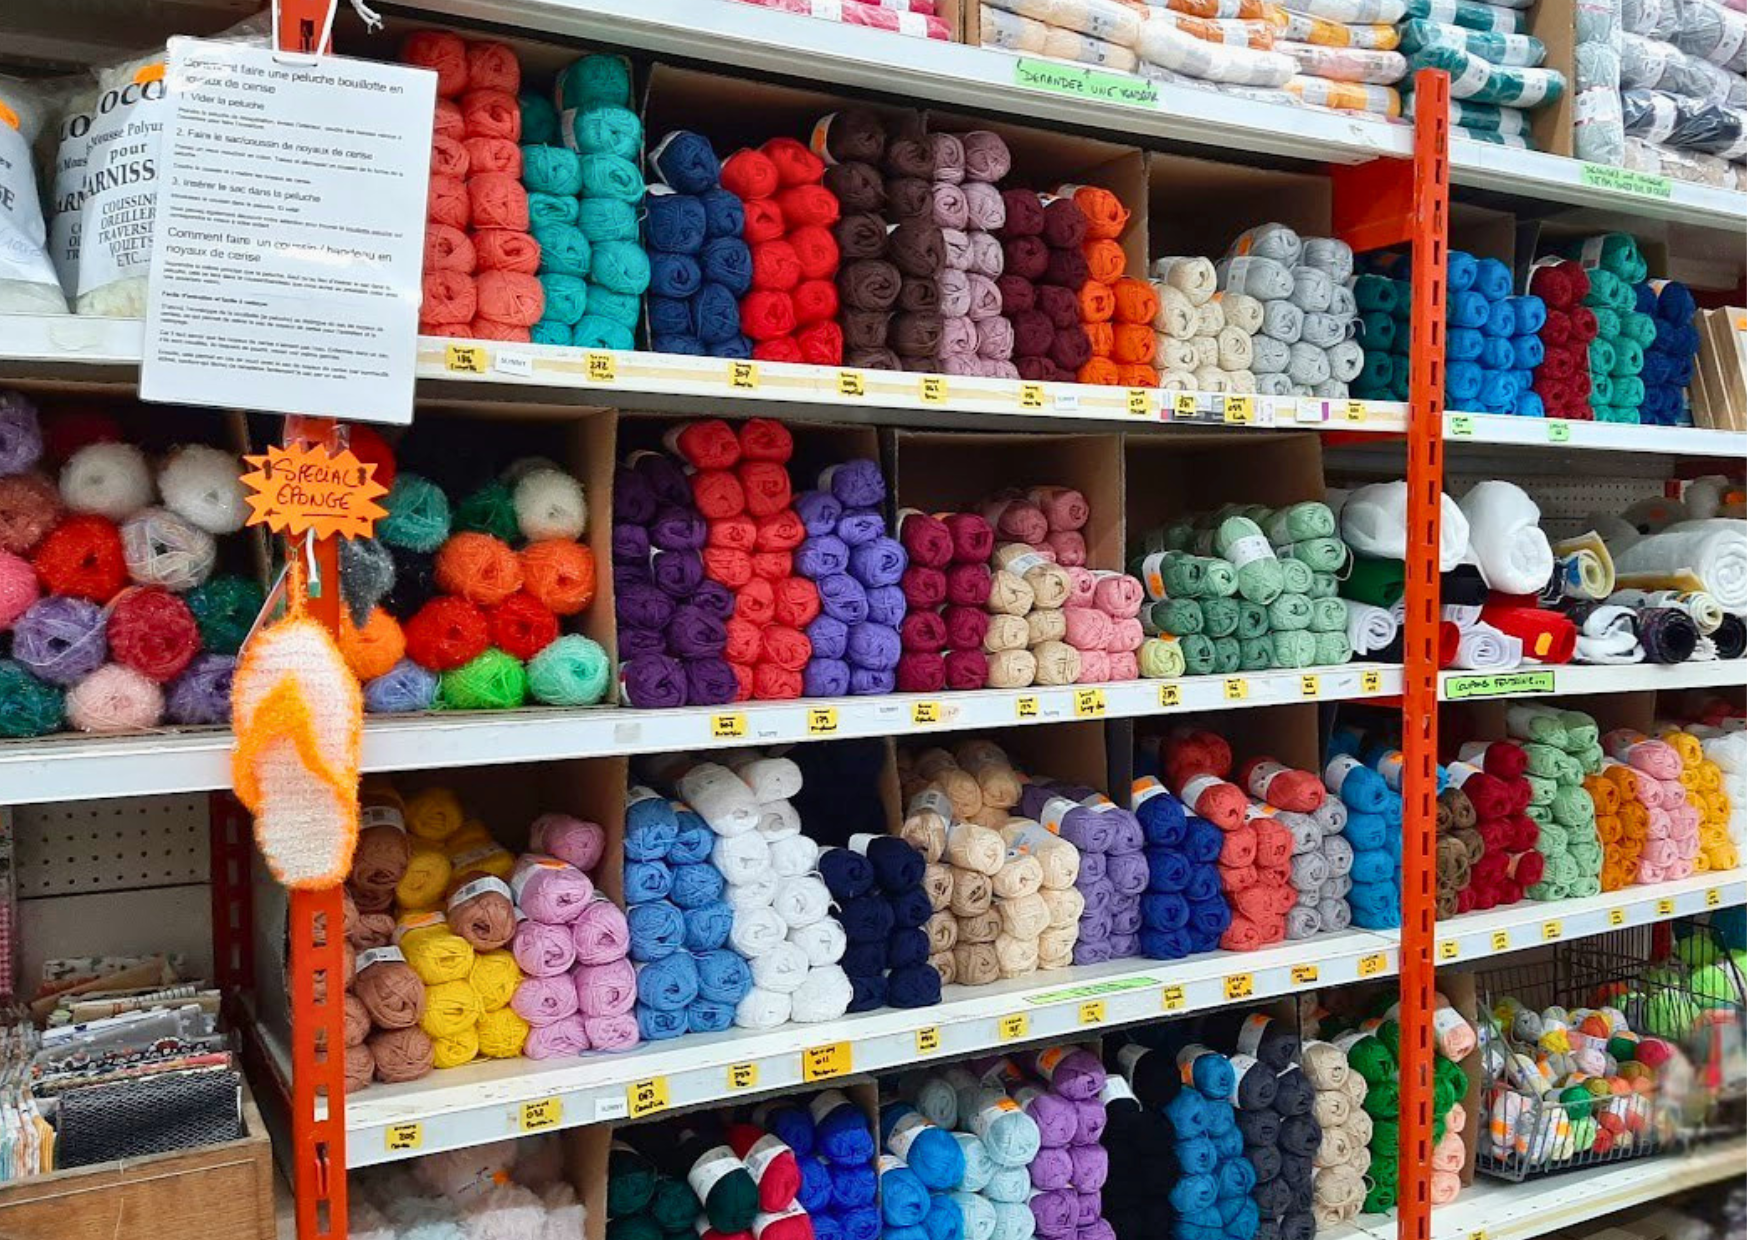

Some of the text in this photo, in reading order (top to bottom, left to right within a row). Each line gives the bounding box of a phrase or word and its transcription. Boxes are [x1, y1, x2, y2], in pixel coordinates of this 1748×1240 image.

[225, 78, 239, 88] de
[241, 64, 264, 77] faire
[268, 69, 289, 79] une
[291, 72, 334, 85] peluche
[338, 77, 387, 92] bouillotte
[389, 84, 403, 93] en
[1024, 70, 1084, 92] DEMANDEZ
[1091, 85, 1118, 97] UNE
[190, 92, 216, 102] Vider
[218, 95, 226, 105] la
[228, 98, 265, 110] peluche
[109, 142, 148, 164] pour
[187, 128, 211, 140] Faire
[214, 131, 223, 140] le
[282, 141, 293, 150] de
[332, 147, 343, 157] de
[218, 182, 228, 191] le
[229, 184, 246, 194] sac
[248, 185, 272, 197] dans
[273, 189, 282, 199] la
[284, 189, 322, 203] peluche
[166, 244, 207, 257] noyaux
[209, 248, 225, 259] de
[168, 226, 223, 243] Comment
[226, 233, 251, 245] faire
[256, 237, 272, 247] un
[377, 252, 392, 263] en
[276, 483, 354, 511] EPONGE
